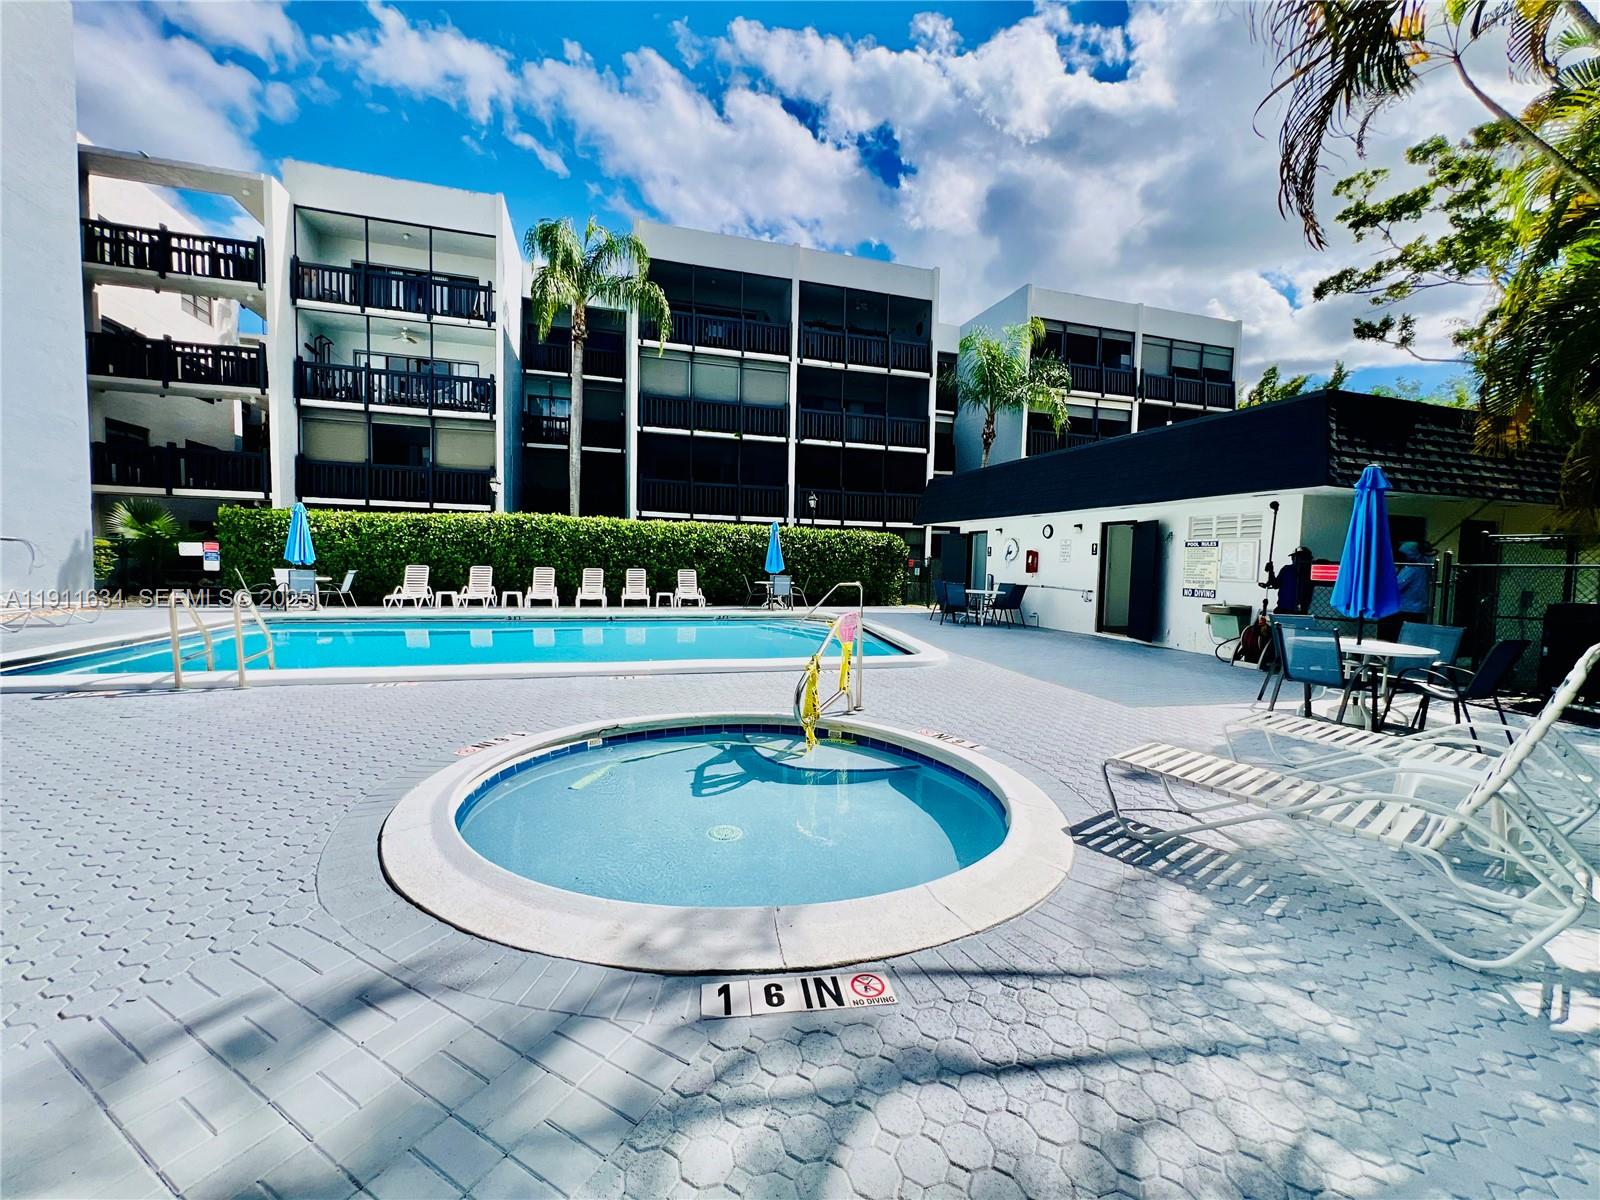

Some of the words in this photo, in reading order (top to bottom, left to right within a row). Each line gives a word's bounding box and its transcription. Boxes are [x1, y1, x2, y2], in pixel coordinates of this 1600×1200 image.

[1194, 589, 1215, 598] DIVING
[717, 983, 732, 1016] 1
[763, 983, 785, 1008] 6
[800, 976, 845, 1009] IN
[866, 996, 895, 1005] DIVING
